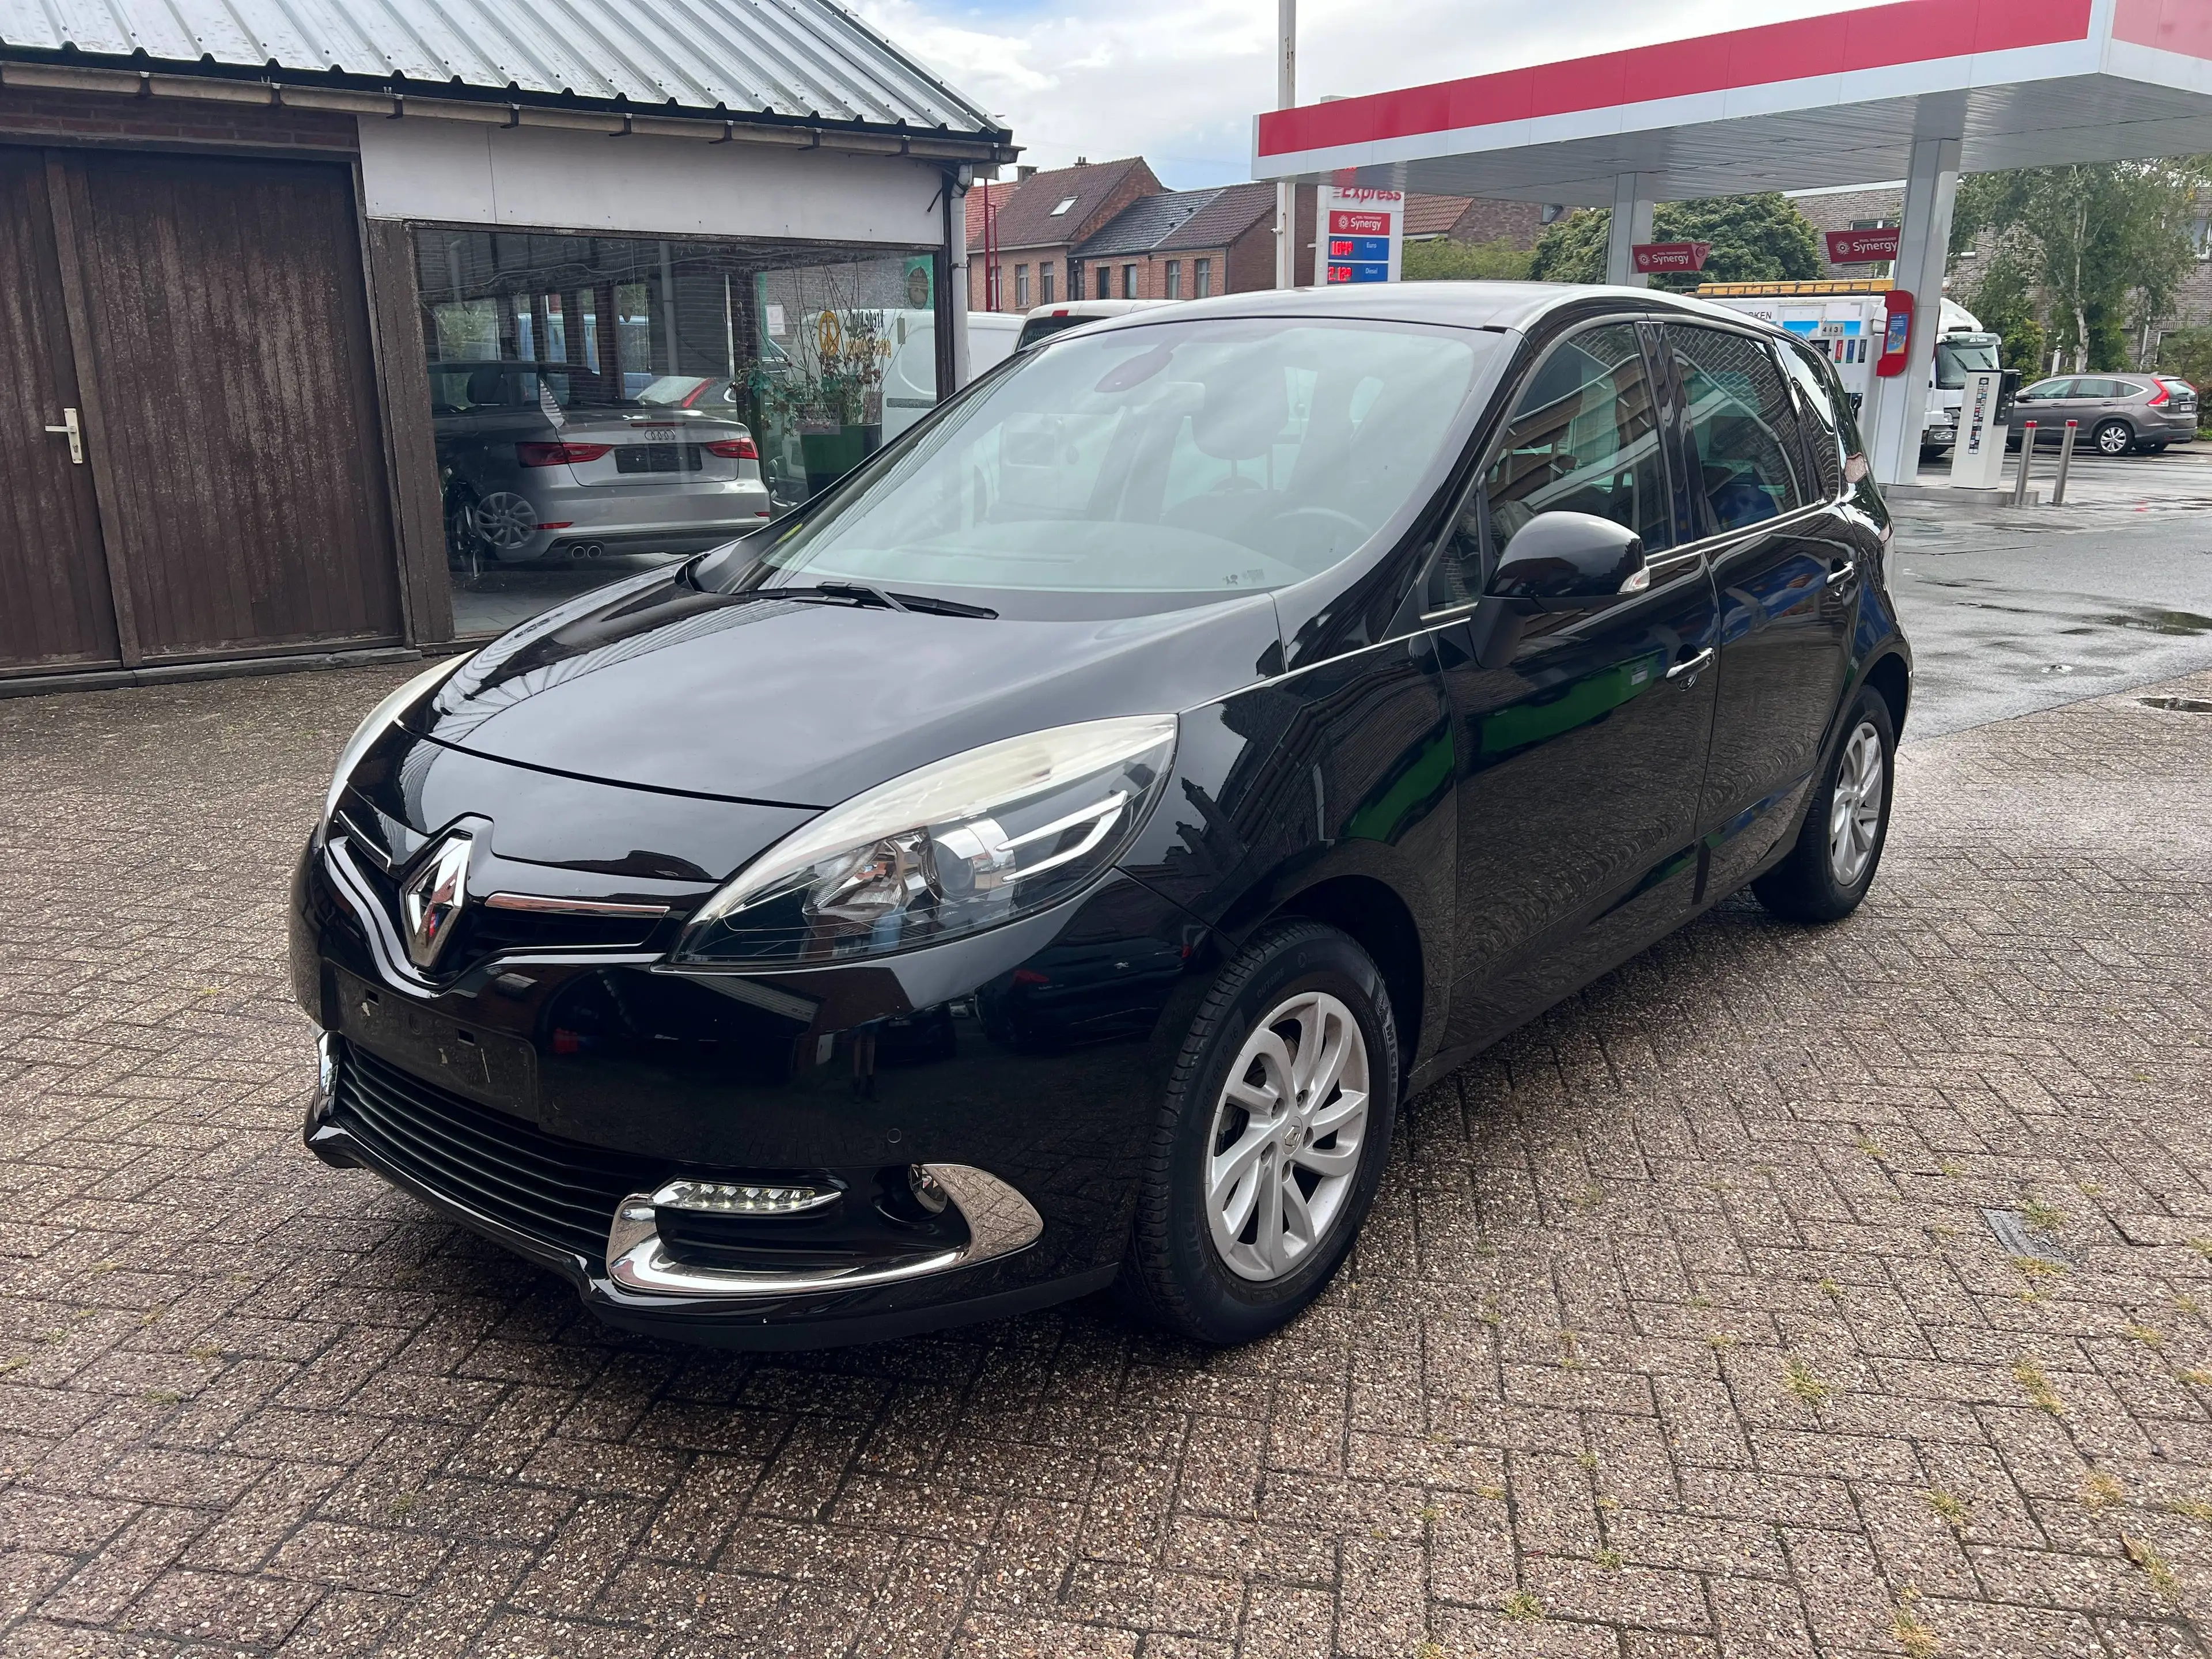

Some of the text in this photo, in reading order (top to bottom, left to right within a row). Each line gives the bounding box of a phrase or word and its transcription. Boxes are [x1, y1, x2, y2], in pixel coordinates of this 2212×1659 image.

[1341, 187, 1402, 203] Express
[1350, 218, 1382, 231] Synergy
[1853, 241, 1898, 254] Synergy
[1652, 254, 1689, 265] Synergy
[1256, 967, 1285, 999] OUTSIDE
